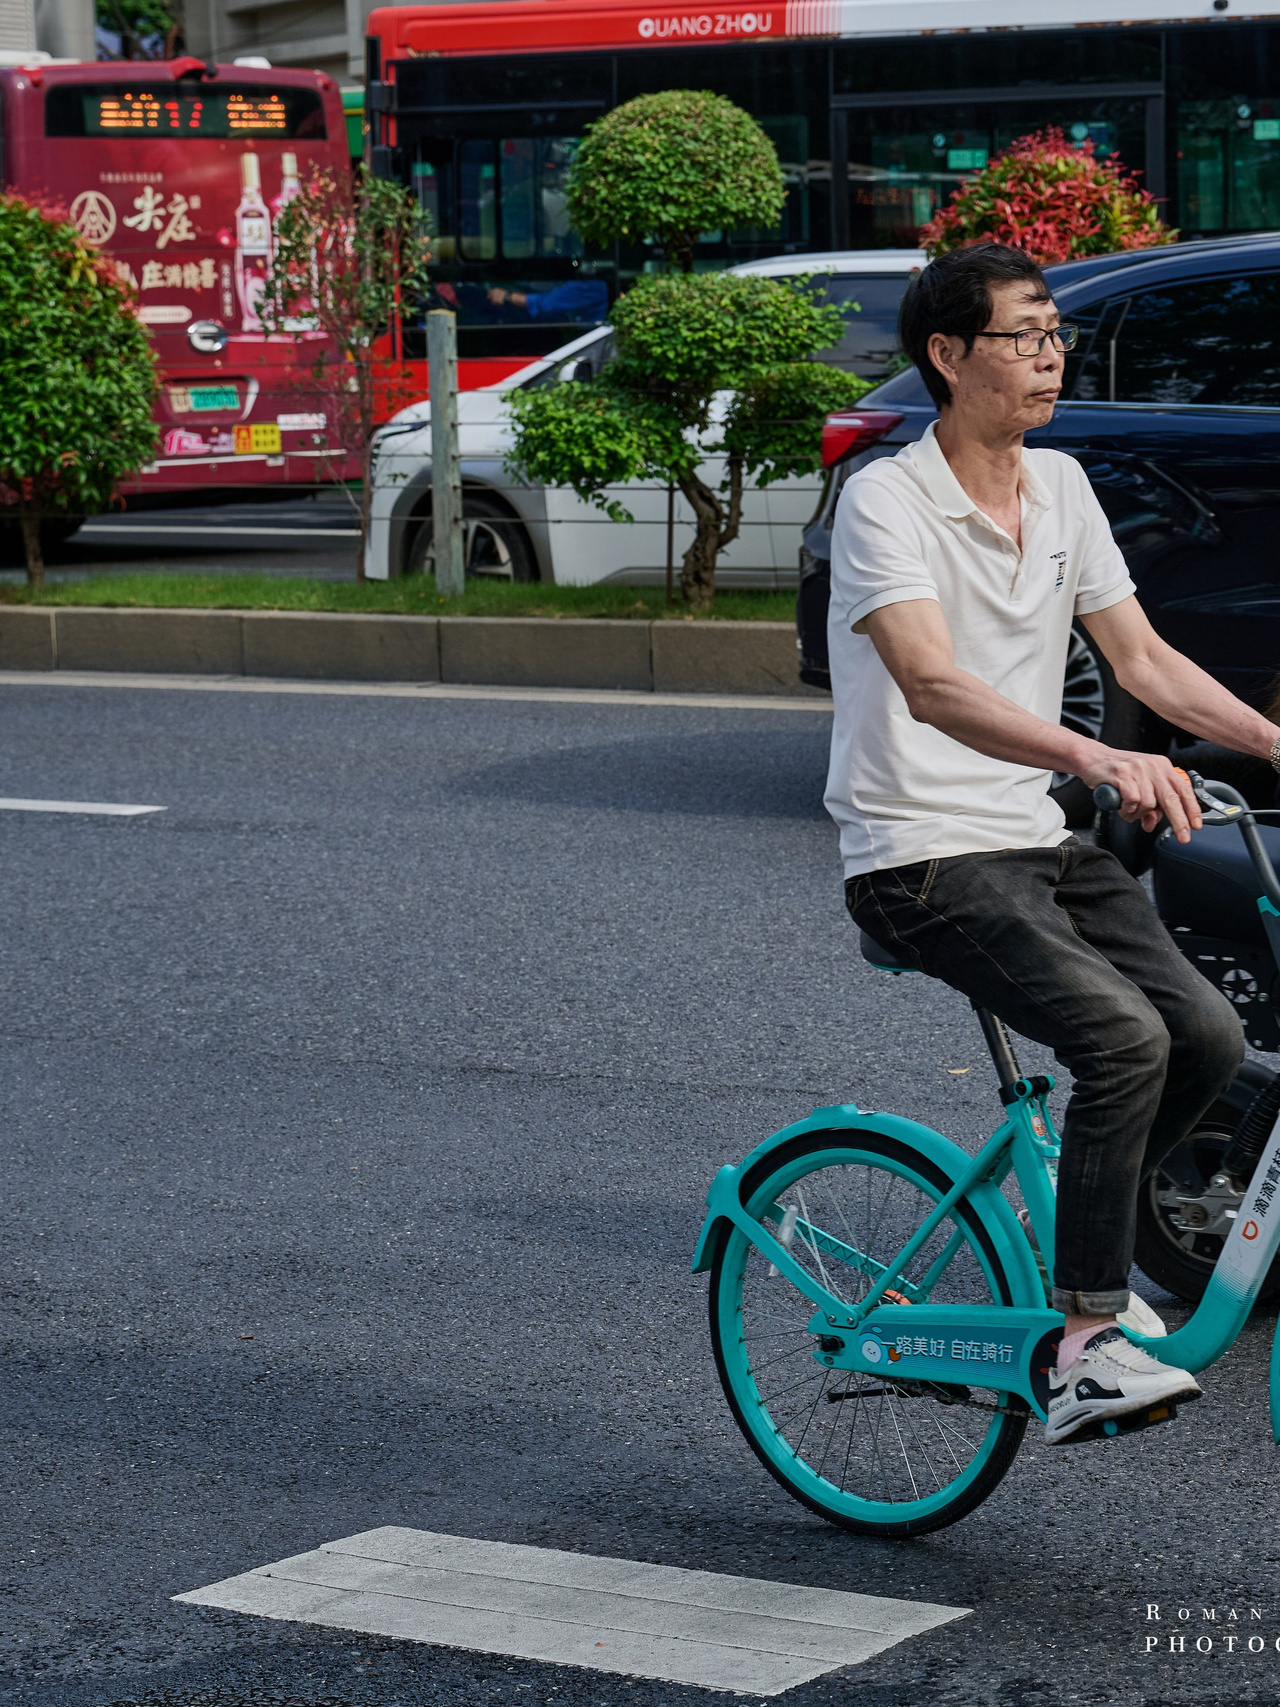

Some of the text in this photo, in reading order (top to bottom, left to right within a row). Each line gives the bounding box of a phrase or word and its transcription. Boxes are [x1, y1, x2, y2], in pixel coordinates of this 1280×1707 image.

[880, 1335, 1014, 1363] 一路美好 自在骑行
